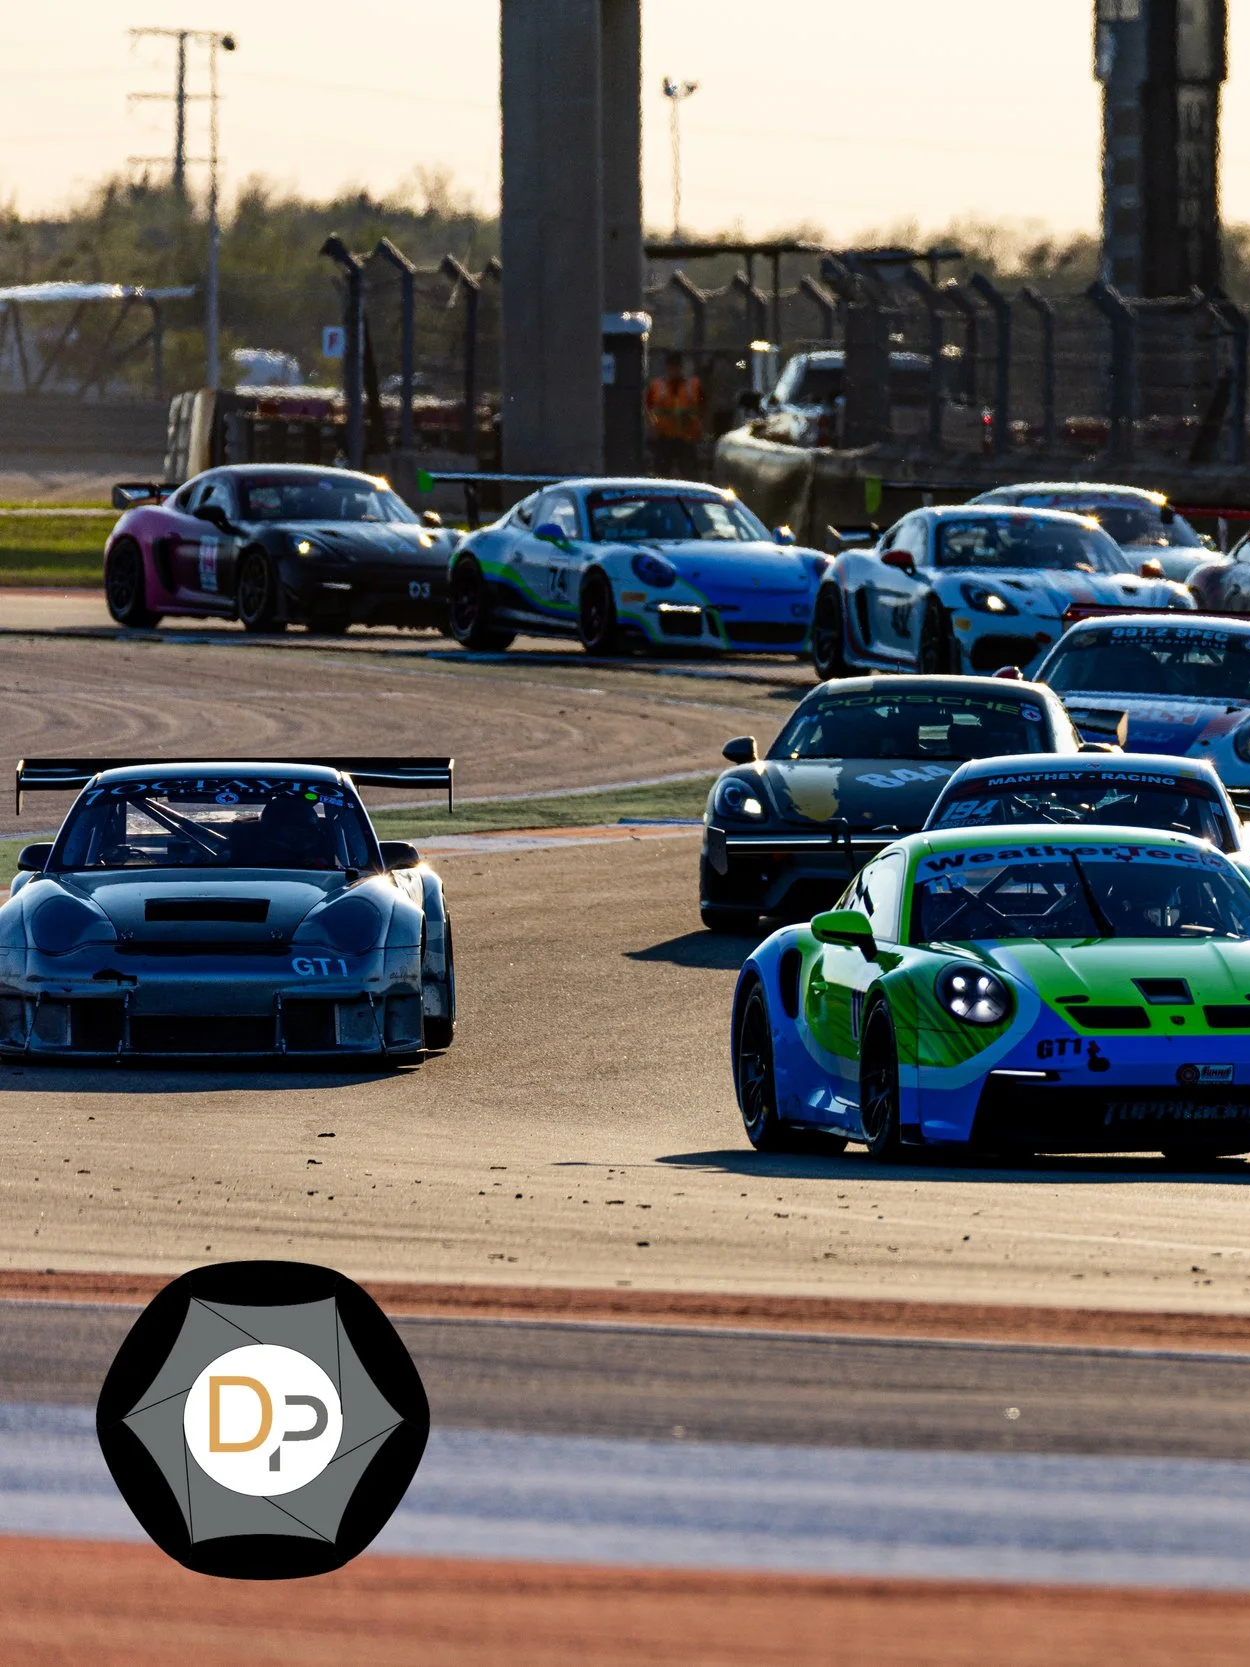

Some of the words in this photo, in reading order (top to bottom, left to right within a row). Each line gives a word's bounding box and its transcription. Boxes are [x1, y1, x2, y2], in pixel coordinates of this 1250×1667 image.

[1111, 626, 1169, 639] 991.2
[1174, 627, 1230, 642] SPEC
[817, 694, 1021, 717] PORSCHE
[855, 764, 953, 789] 844
[987, 772, 1084, 787] MANTHEY
[1101, 772, 1177, 786] RACING
[111, 779, 345, 798] OCTAVIO
[940, 799, 1000, 822] 194
[1036, 1038, 1082, 1060] GT1
